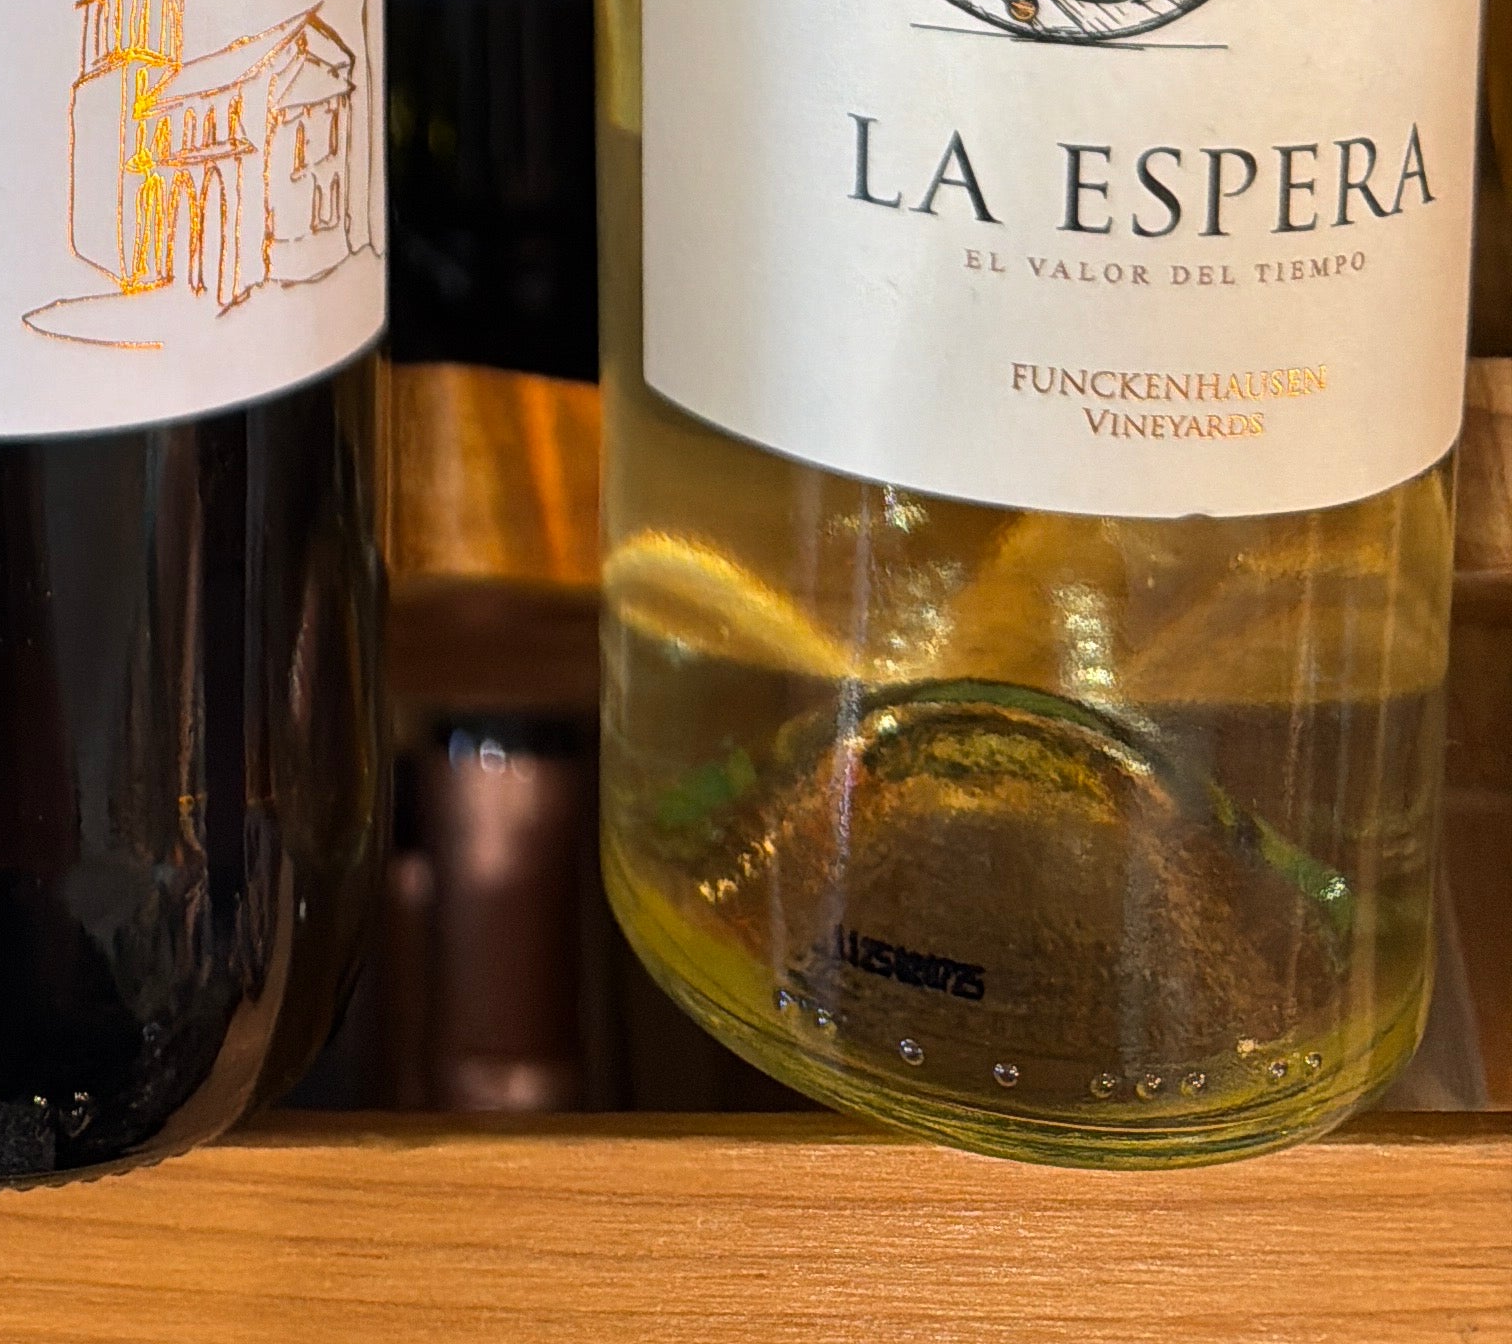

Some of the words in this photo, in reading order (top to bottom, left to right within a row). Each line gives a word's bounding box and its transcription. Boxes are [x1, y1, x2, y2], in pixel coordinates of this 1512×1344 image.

[846, 111, 1002, 225] LA
[1055, 122, 1436, 239] ESPERA
[964, 248, 1007, 273] EL
[1027, 256, 1151, 286] VALOR
[1171, 265, 1236, 286] DEL
[1255, 250, 1367, 284] TIEMPO
[1011, 362, 1328, 402] FUNCKENHAUSEN
[1082, 406, 1266, 439] VINEYARDS
